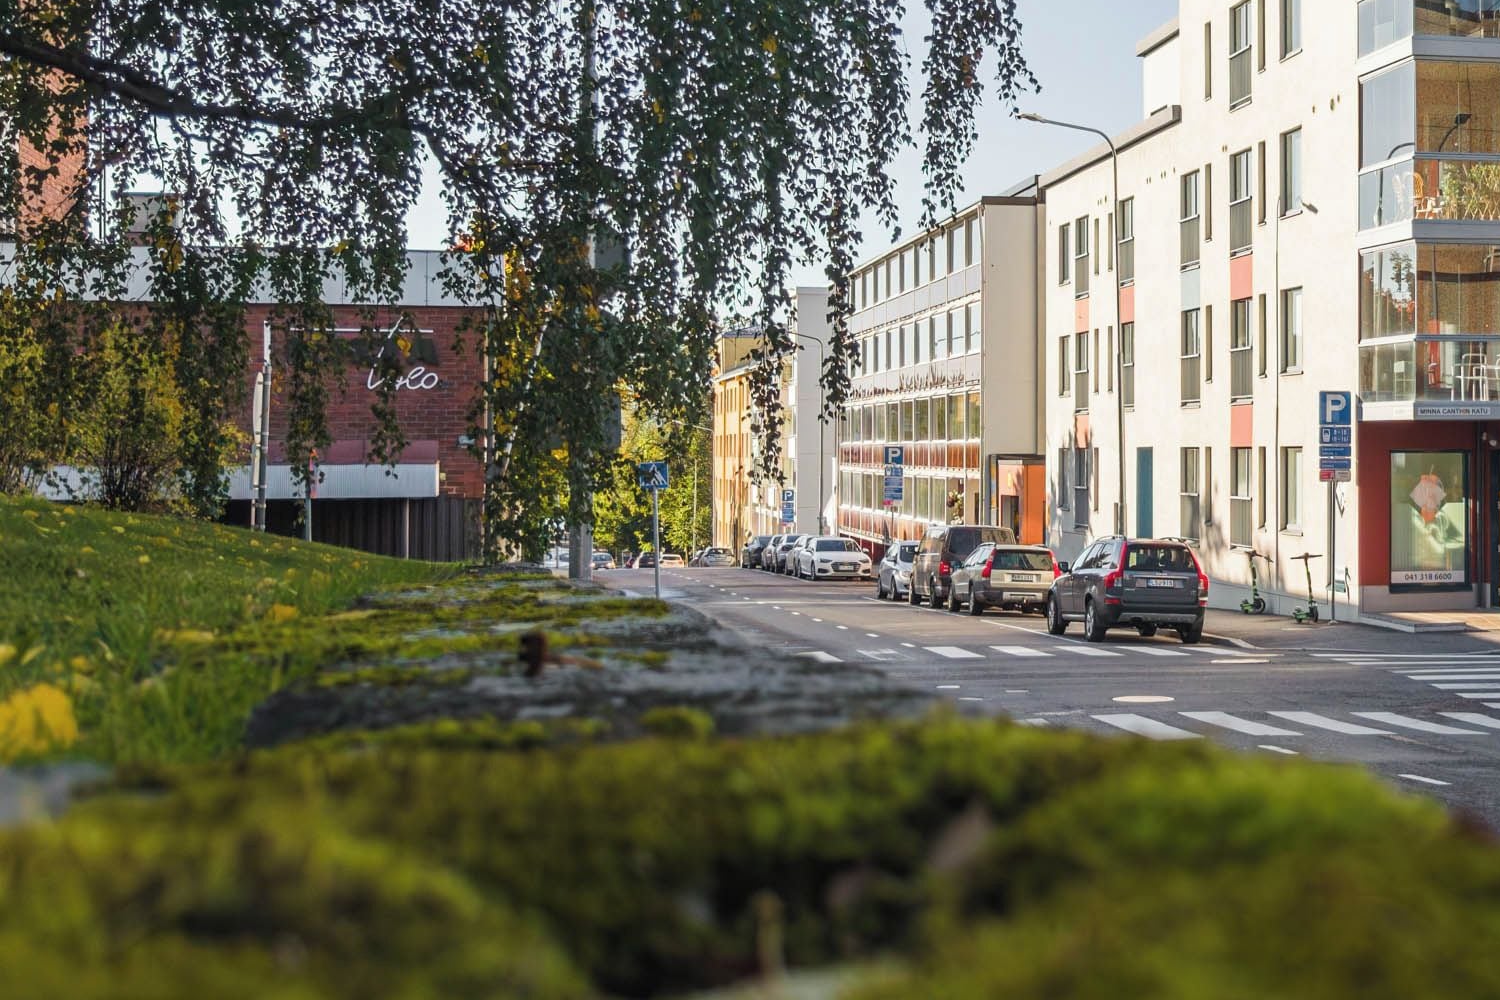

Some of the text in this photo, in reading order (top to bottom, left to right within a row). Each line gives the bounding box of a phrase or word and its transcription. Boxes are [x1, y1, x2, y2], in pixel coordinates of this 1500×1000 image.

[1326, 394, 1346, 422] P
[888, 447, 901, 464] P
[784, 490, 793, 501] P
[1434, 573, 1452, 581] 6600
